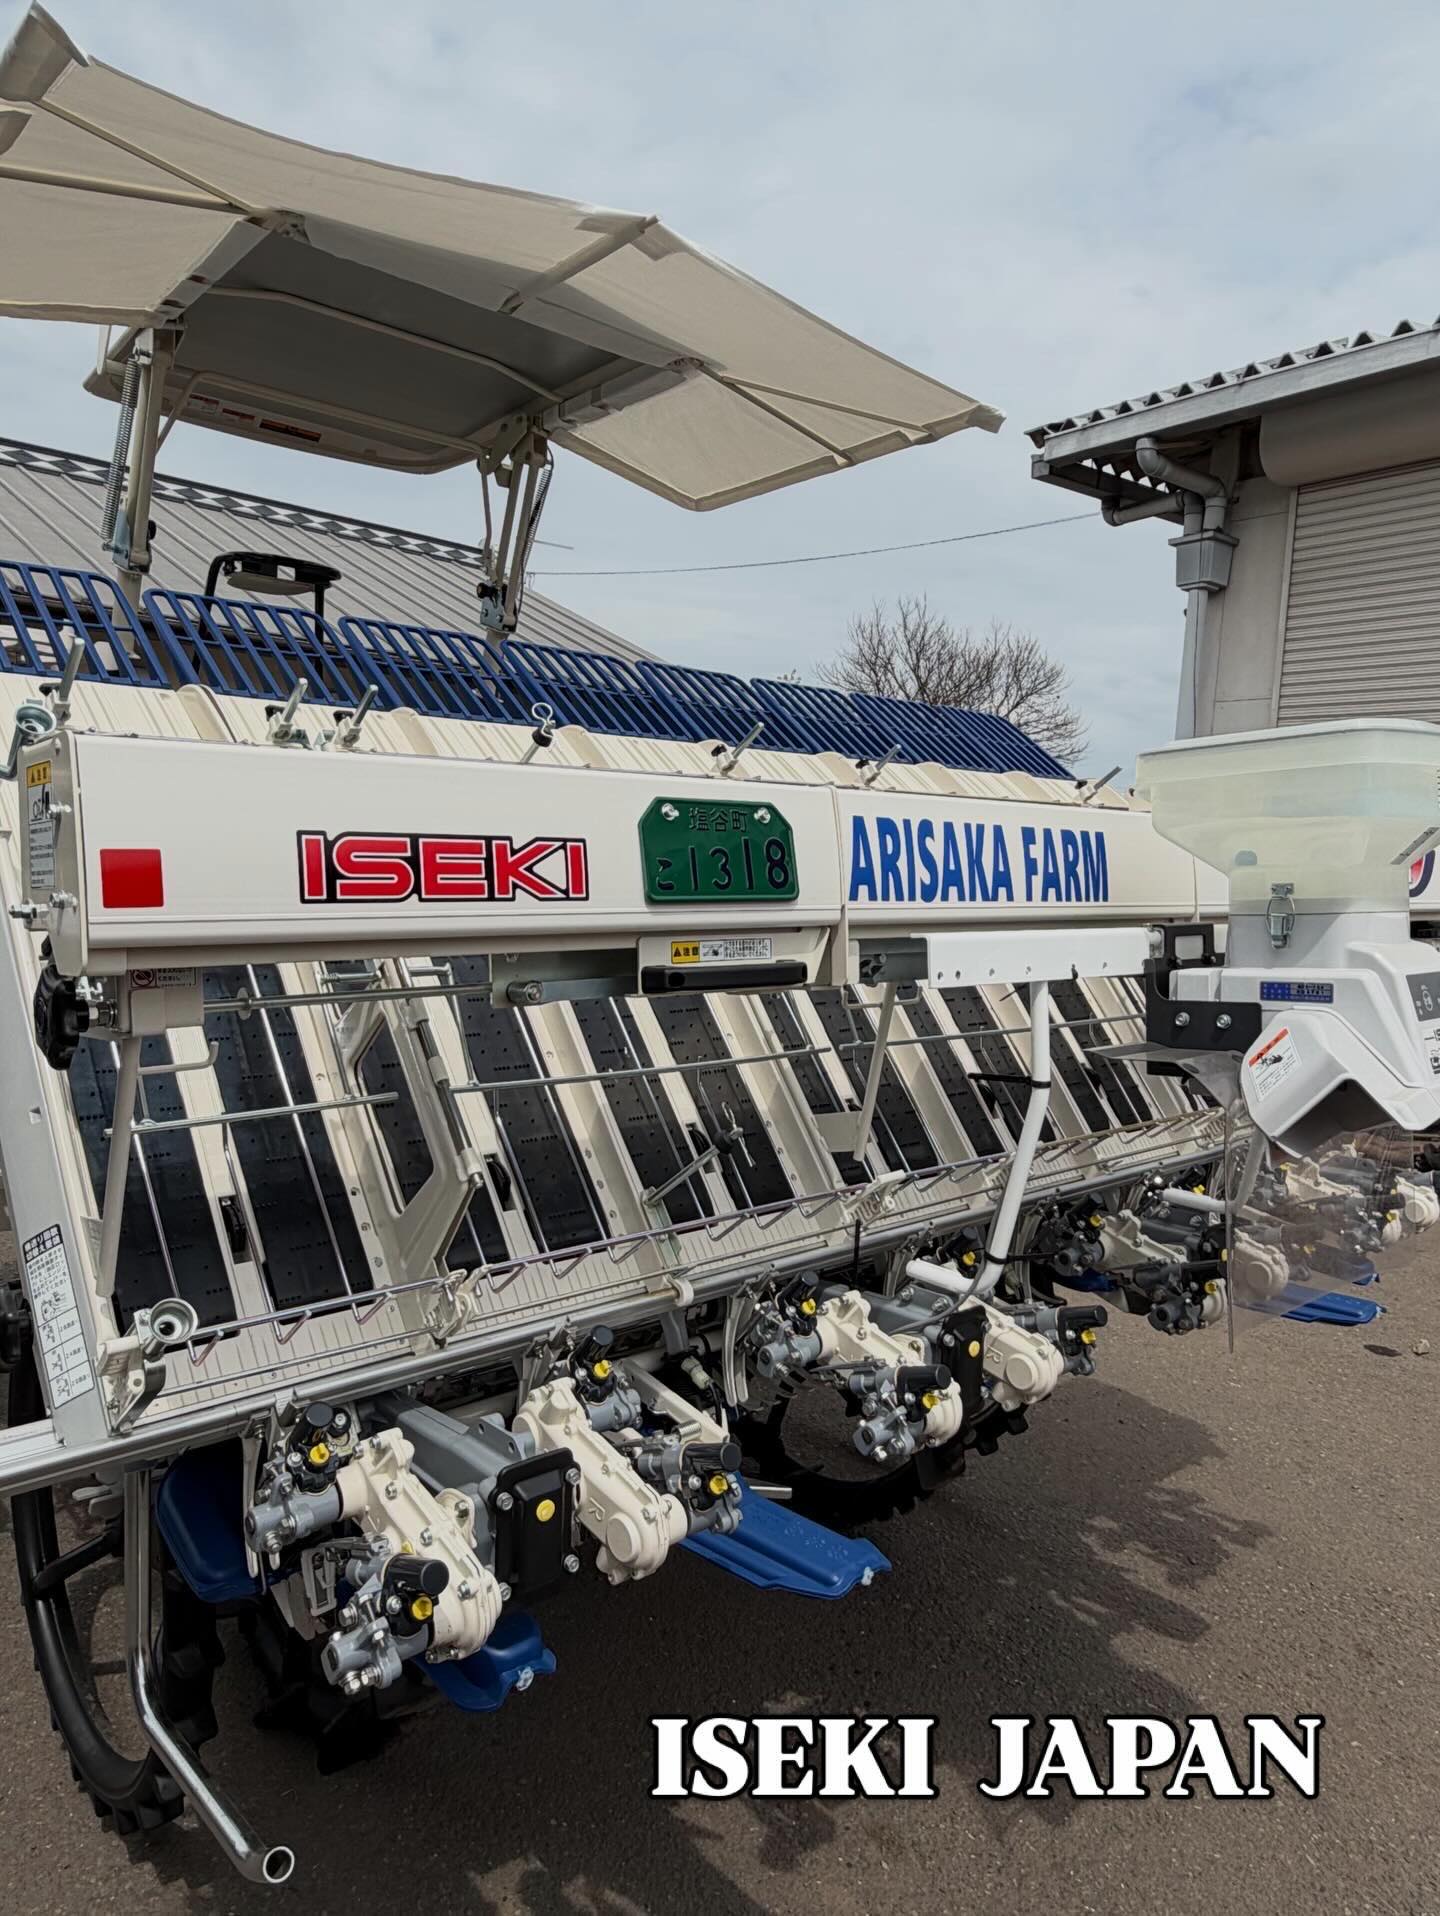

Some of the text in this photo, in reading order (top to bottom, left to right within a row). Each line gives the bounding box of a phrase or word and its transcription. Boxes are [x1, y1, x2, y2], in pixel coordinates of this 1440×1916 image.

[688, 807, 748, 832] 塩谷町
[298, 831, 589, 903] ISEKI
[688, 836, 790, 891] 1318
[849, 815, 1109, 903] ARISAKA FARM
